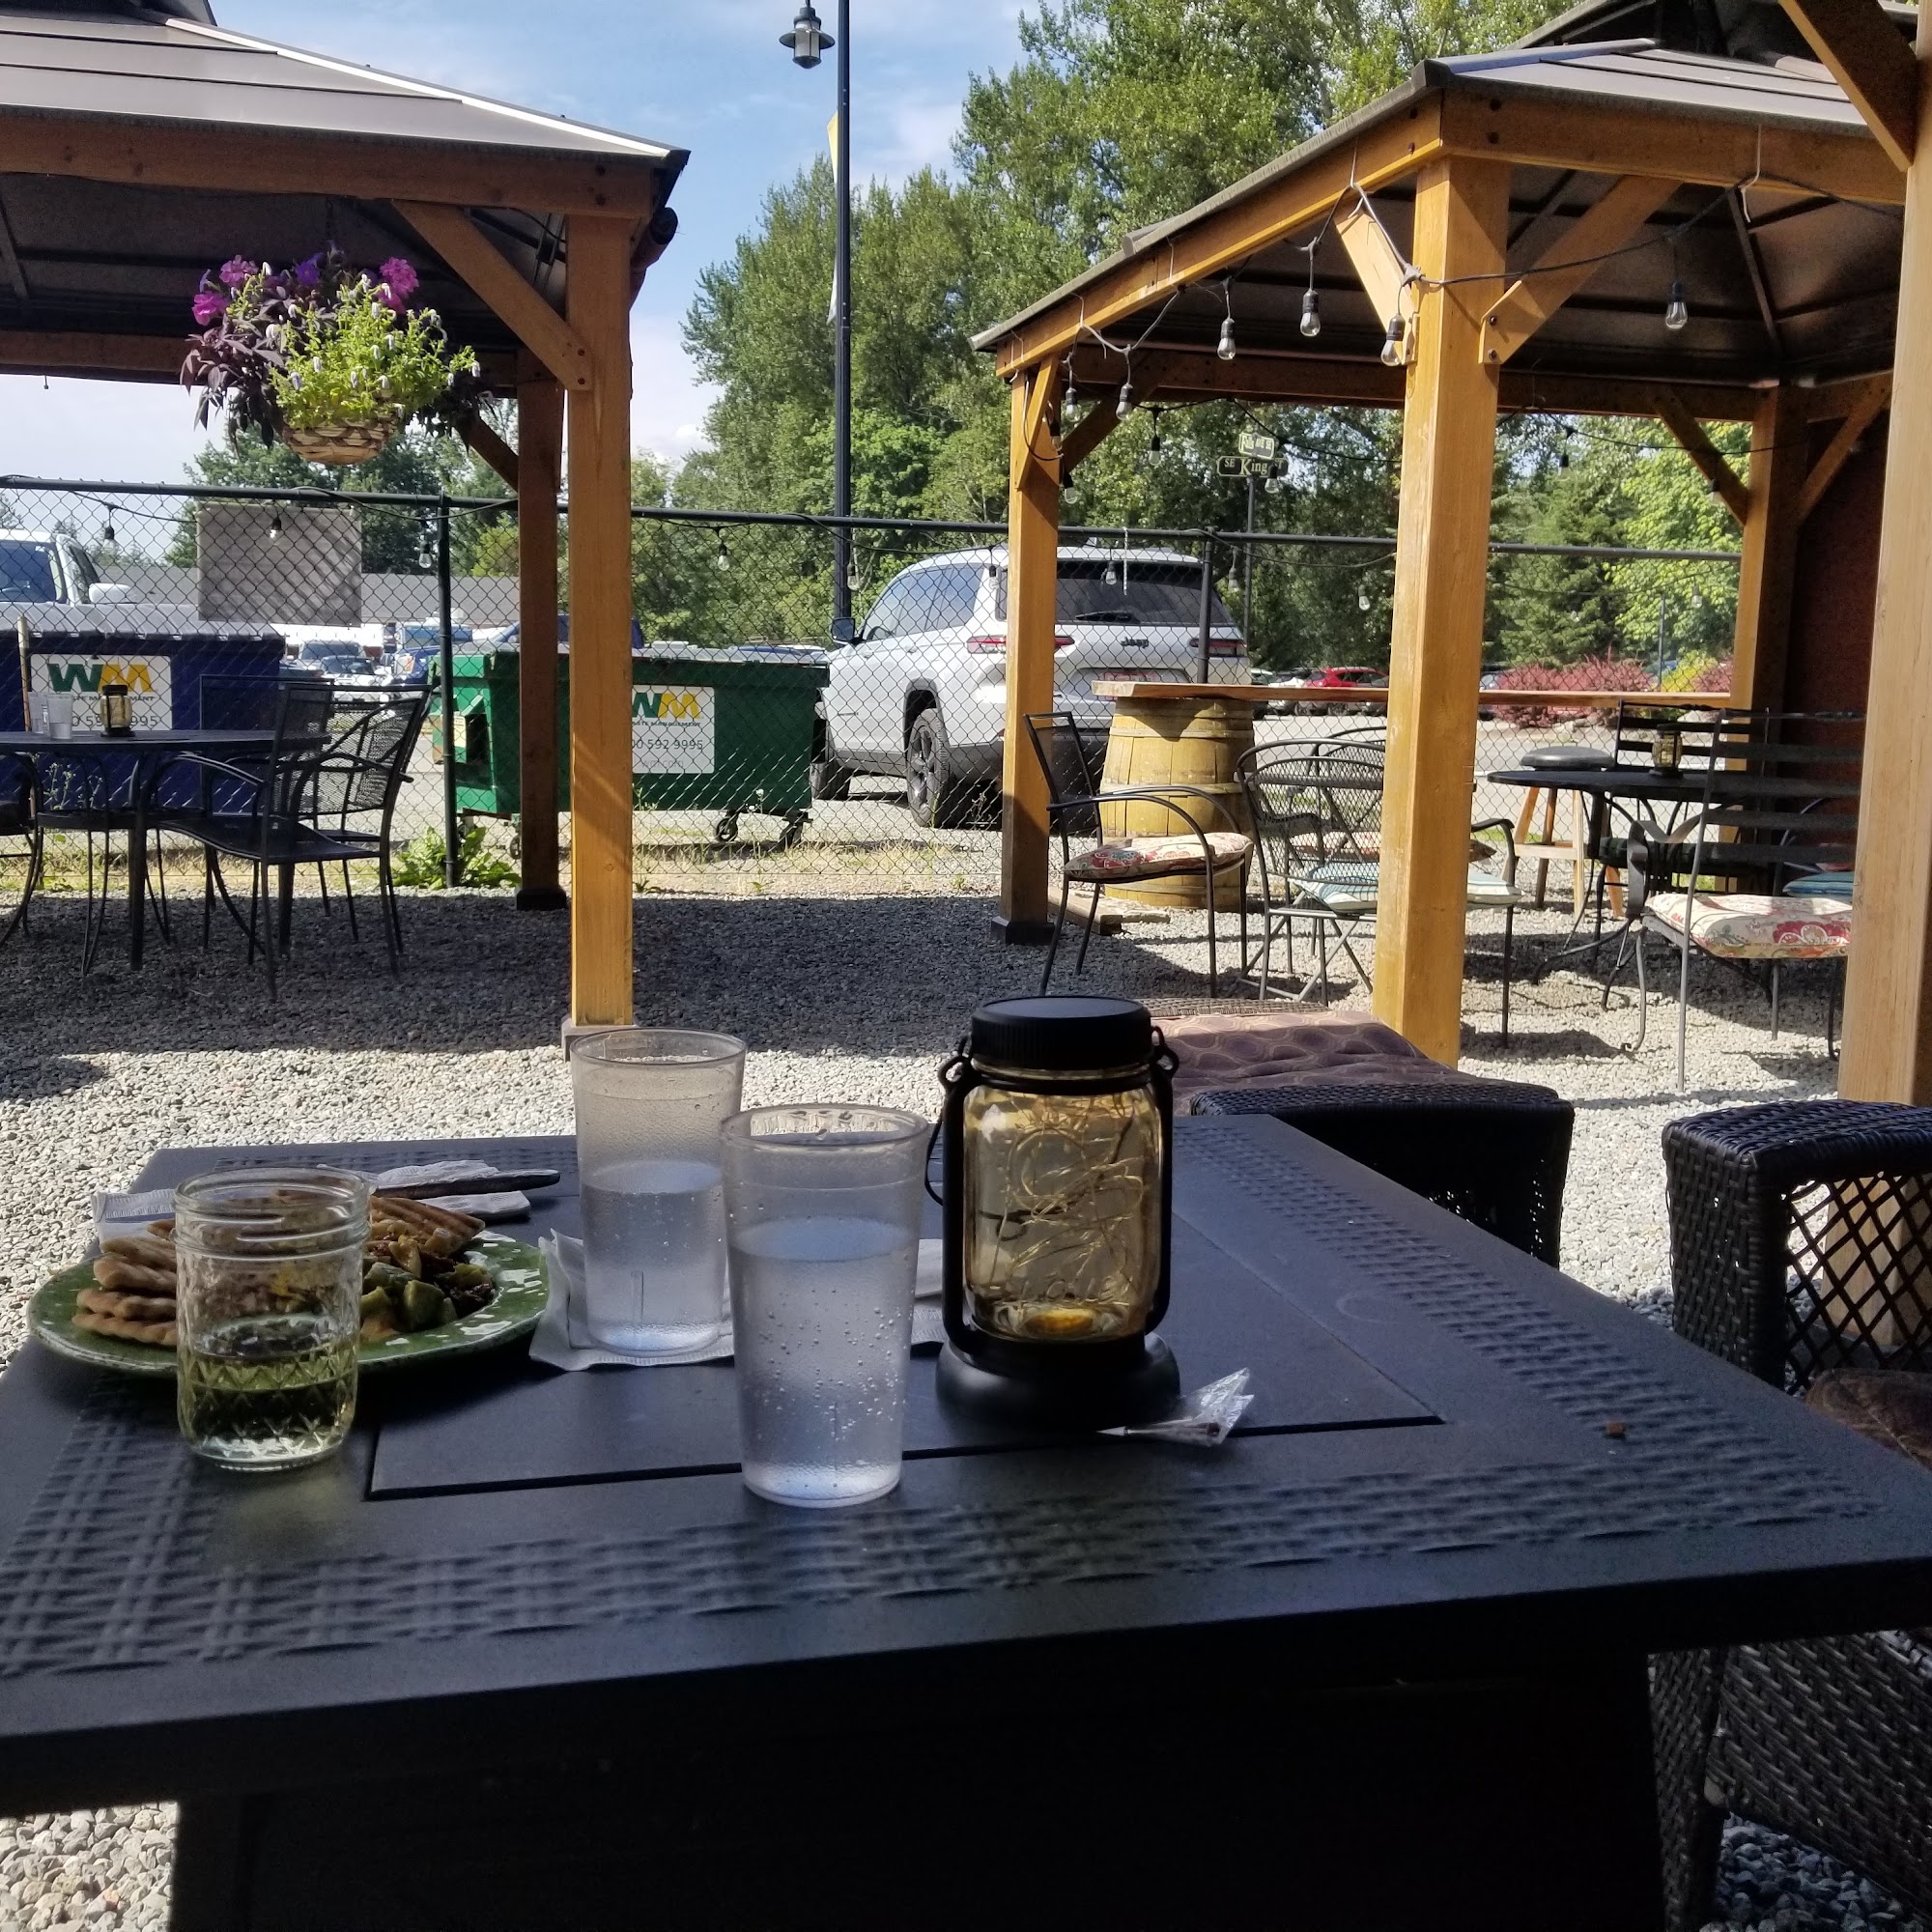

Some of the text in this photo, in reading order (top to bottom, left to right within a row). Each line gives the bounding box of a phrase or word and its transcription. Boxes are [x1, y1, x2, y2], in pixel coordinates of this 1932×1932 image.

[1224, 458, 1236, 469] SE
[1239, 458, 1267, 475] King
[1121, 636, 1150, 649] Jeep
[46, 663, 154, 693] WM
[647, 739, 669, 750] 592
[673, 739, 703, 751] 9995
